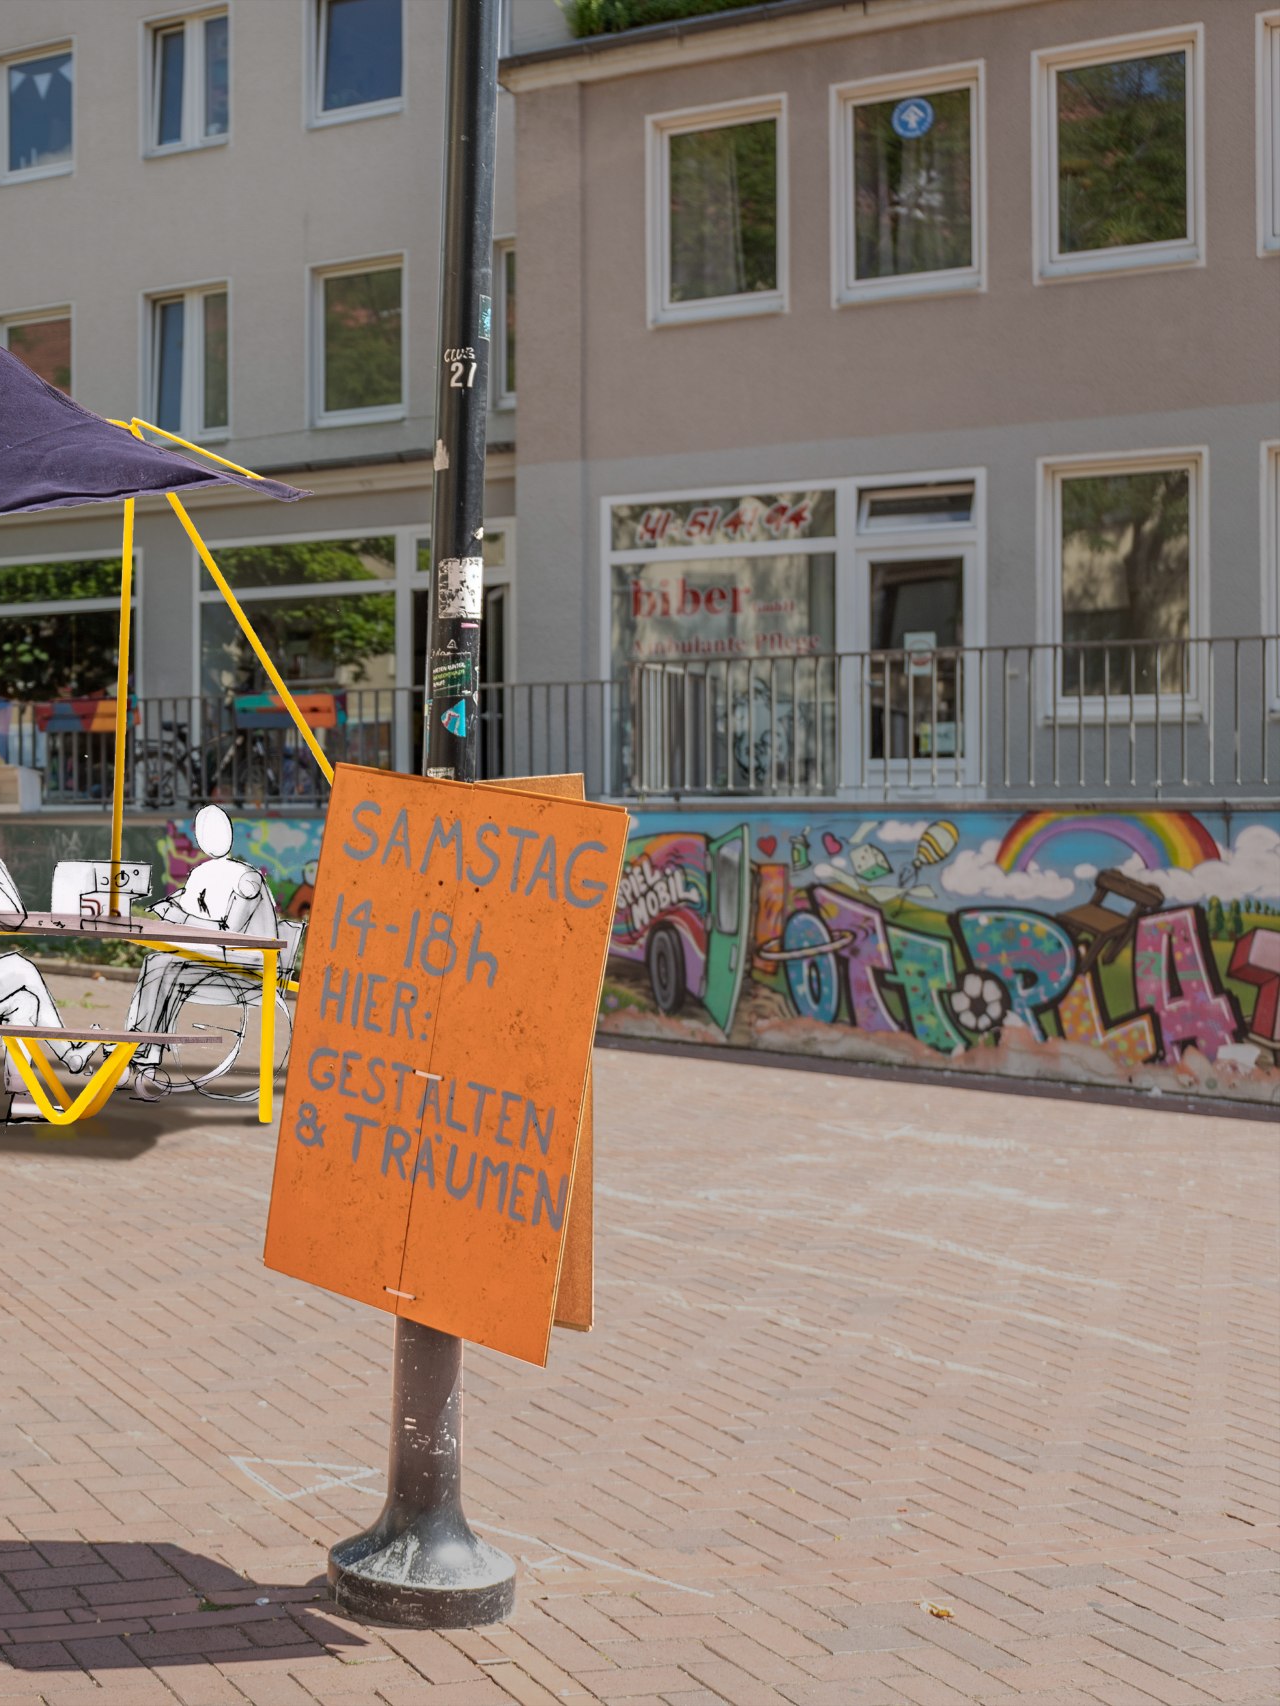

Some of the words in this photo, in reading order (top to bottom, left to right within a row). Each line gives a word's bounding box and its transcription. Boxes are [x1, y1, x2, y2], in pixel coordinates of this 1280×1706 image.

[450, 362, 477, 387] 21
[631, 577, 751, 618] biber
[342, 800, 607, 909] SAMSTAG
[320, 966, 432, 1042] HIER:
[308, 1047, 554, 1155] GESTALTEN
[295, 1102, 326, 1148] &
[344, 1113, 569, 1232] TRÄUMEN
